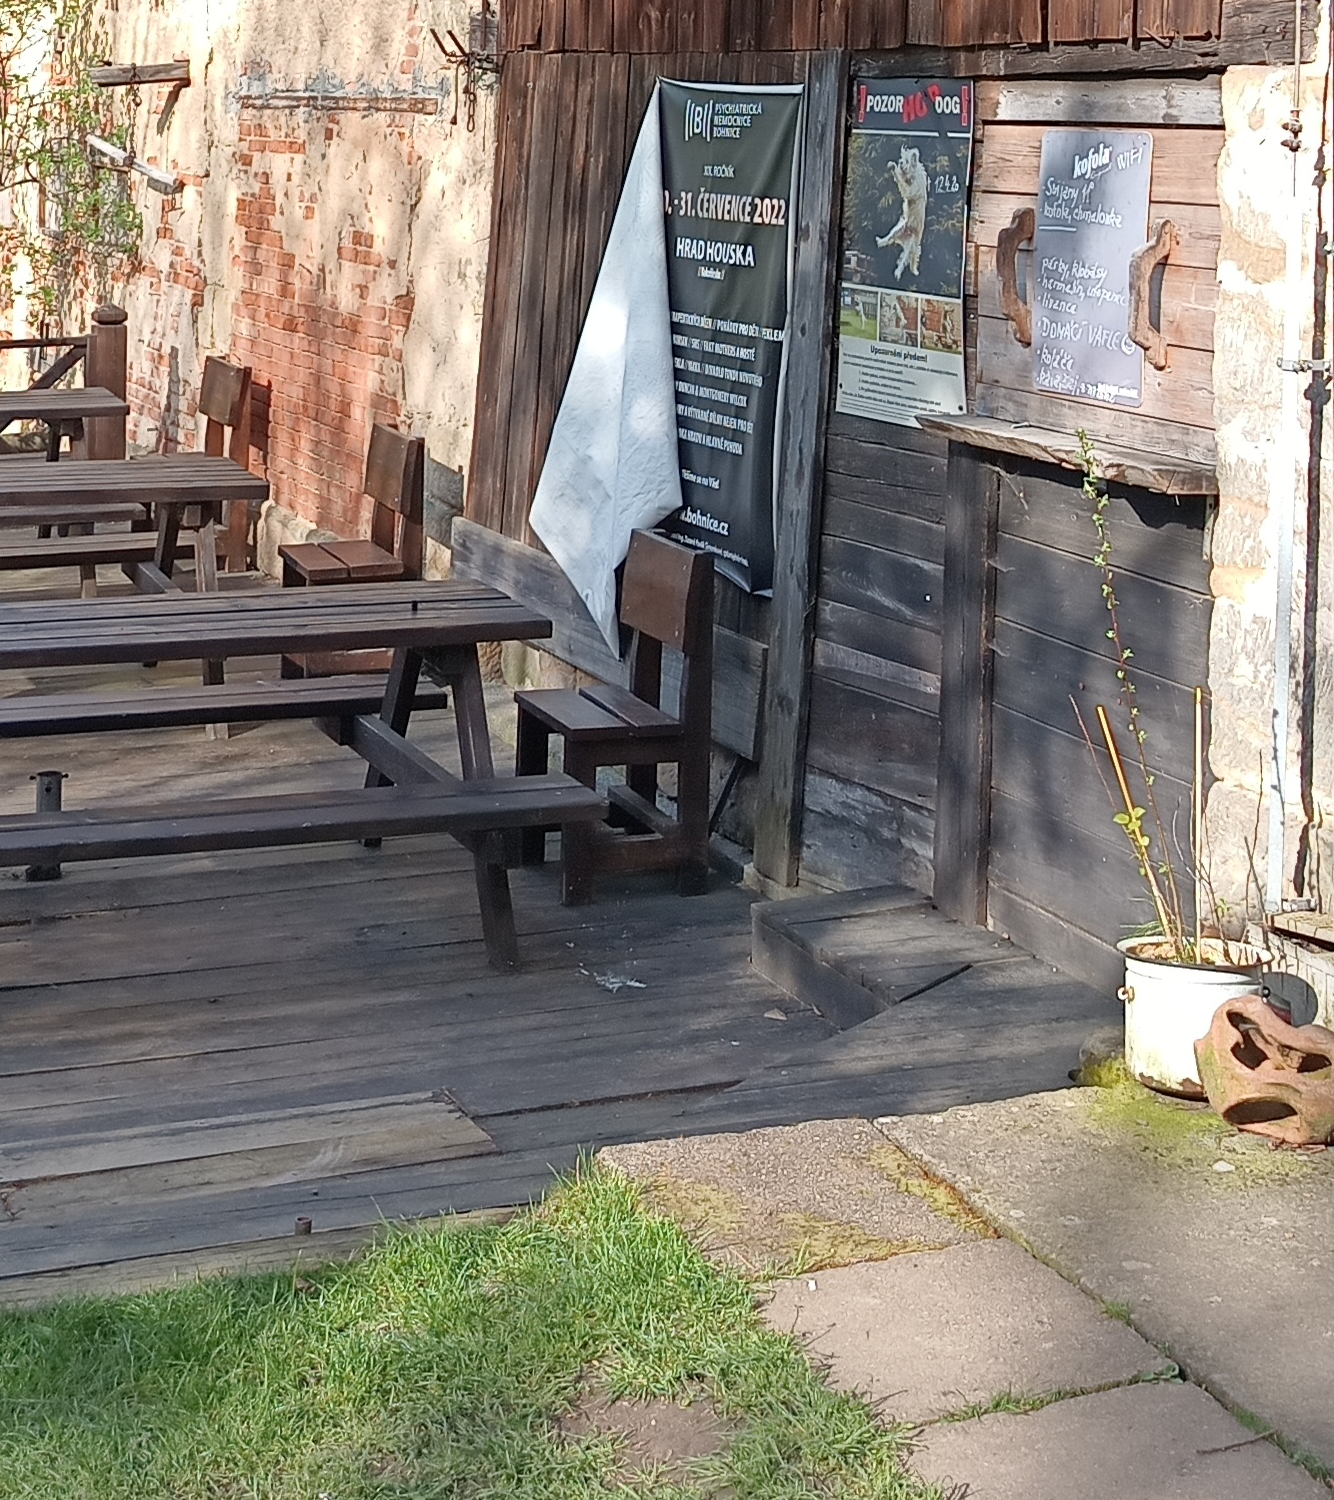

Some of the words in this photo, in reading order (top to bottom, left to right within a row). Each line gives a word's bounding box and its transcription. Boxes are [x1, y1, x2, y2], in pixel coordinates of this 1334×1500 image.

[715, 102, 762, 114] PSYCHIATRICKÁ
[866, 95, 904, 113] POZOR
[934, 95, 960, 114] DOG
[713, 115, 752, 127] NEMOCNICE
[713, 127, 740, 138] BOHNICE
[697, 187, 752, 222] ČERVENCE
[753, 197, 786, 225] 2022
[676, 236, 705, 260] HRAD
[706, 240, 755, 267] HOUSKA
